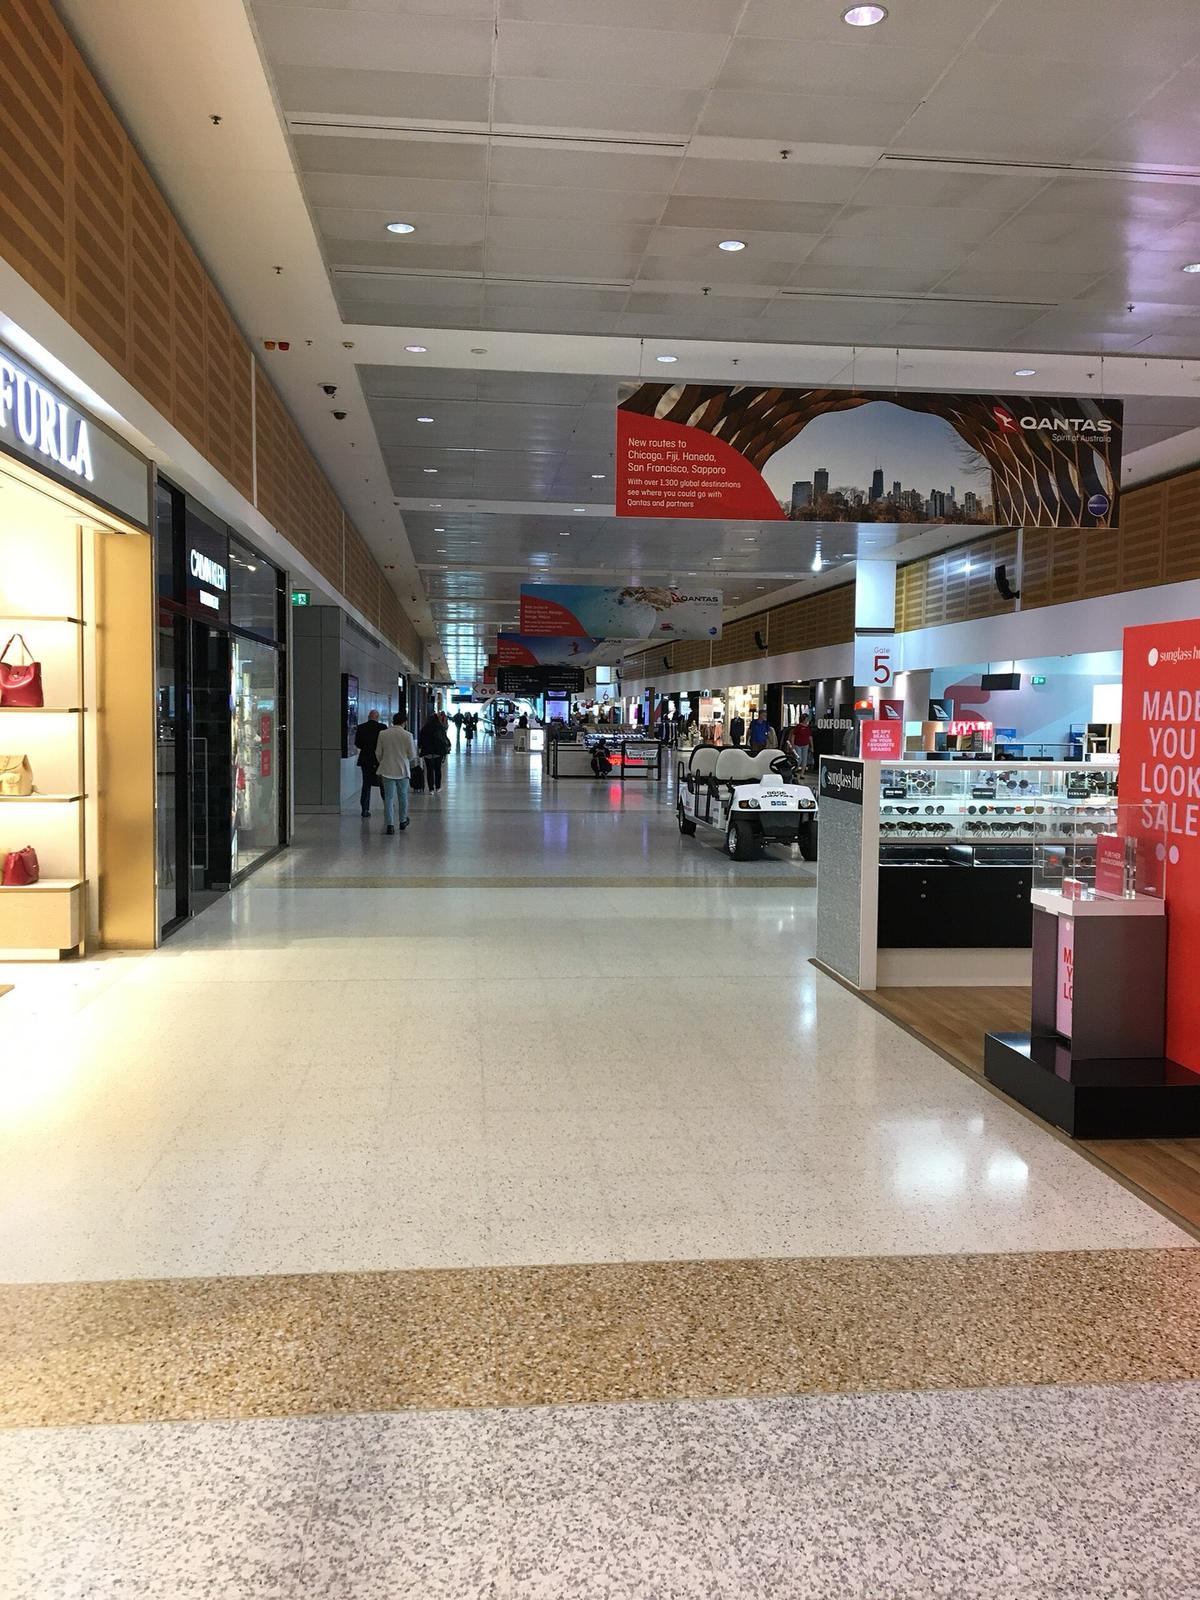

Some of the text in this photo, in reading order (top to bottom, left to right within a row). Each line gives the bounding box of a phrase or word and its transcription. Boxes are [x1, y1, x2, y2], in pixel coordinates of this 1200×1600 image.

[0, 355, 95, 482] FURLA
[1020, 416, 1112, 431] QANTAS
[628, 438, 687, 448] New routes to
[1052, 433, 1112, 443] Spirit of Australia
[628, 450, 717, 463] Chicago, Fiji, Haneda,
[628, 462, 727, 476] San Francisco, Sapporo
[628, 478, 643, 486] With
[660, 479, 679, 487] 1,300
[680, 480, 700, 488] global
[701, 481, 741, 489] destinations
[641, 489, 662, 497] where
[663, 490, 676, 498] you
[677, 490, 696, 498] could
[697, 491, 707, 499] go
[627, 499, 695, 509] Qantas and partners
[873, 646, 890, 654] Gate
[1160, 647, 1192, 665] sunglass
[873, 655, 890, 684] 5
[602, 689, 609, 700] 6
[1149, 727, 1196, 760] YOU
[827, 768, 862, 791] sunglass hut
[1141, 763, 1200, 799] LOOK
[1141, 798, 1198, 836] SALE
